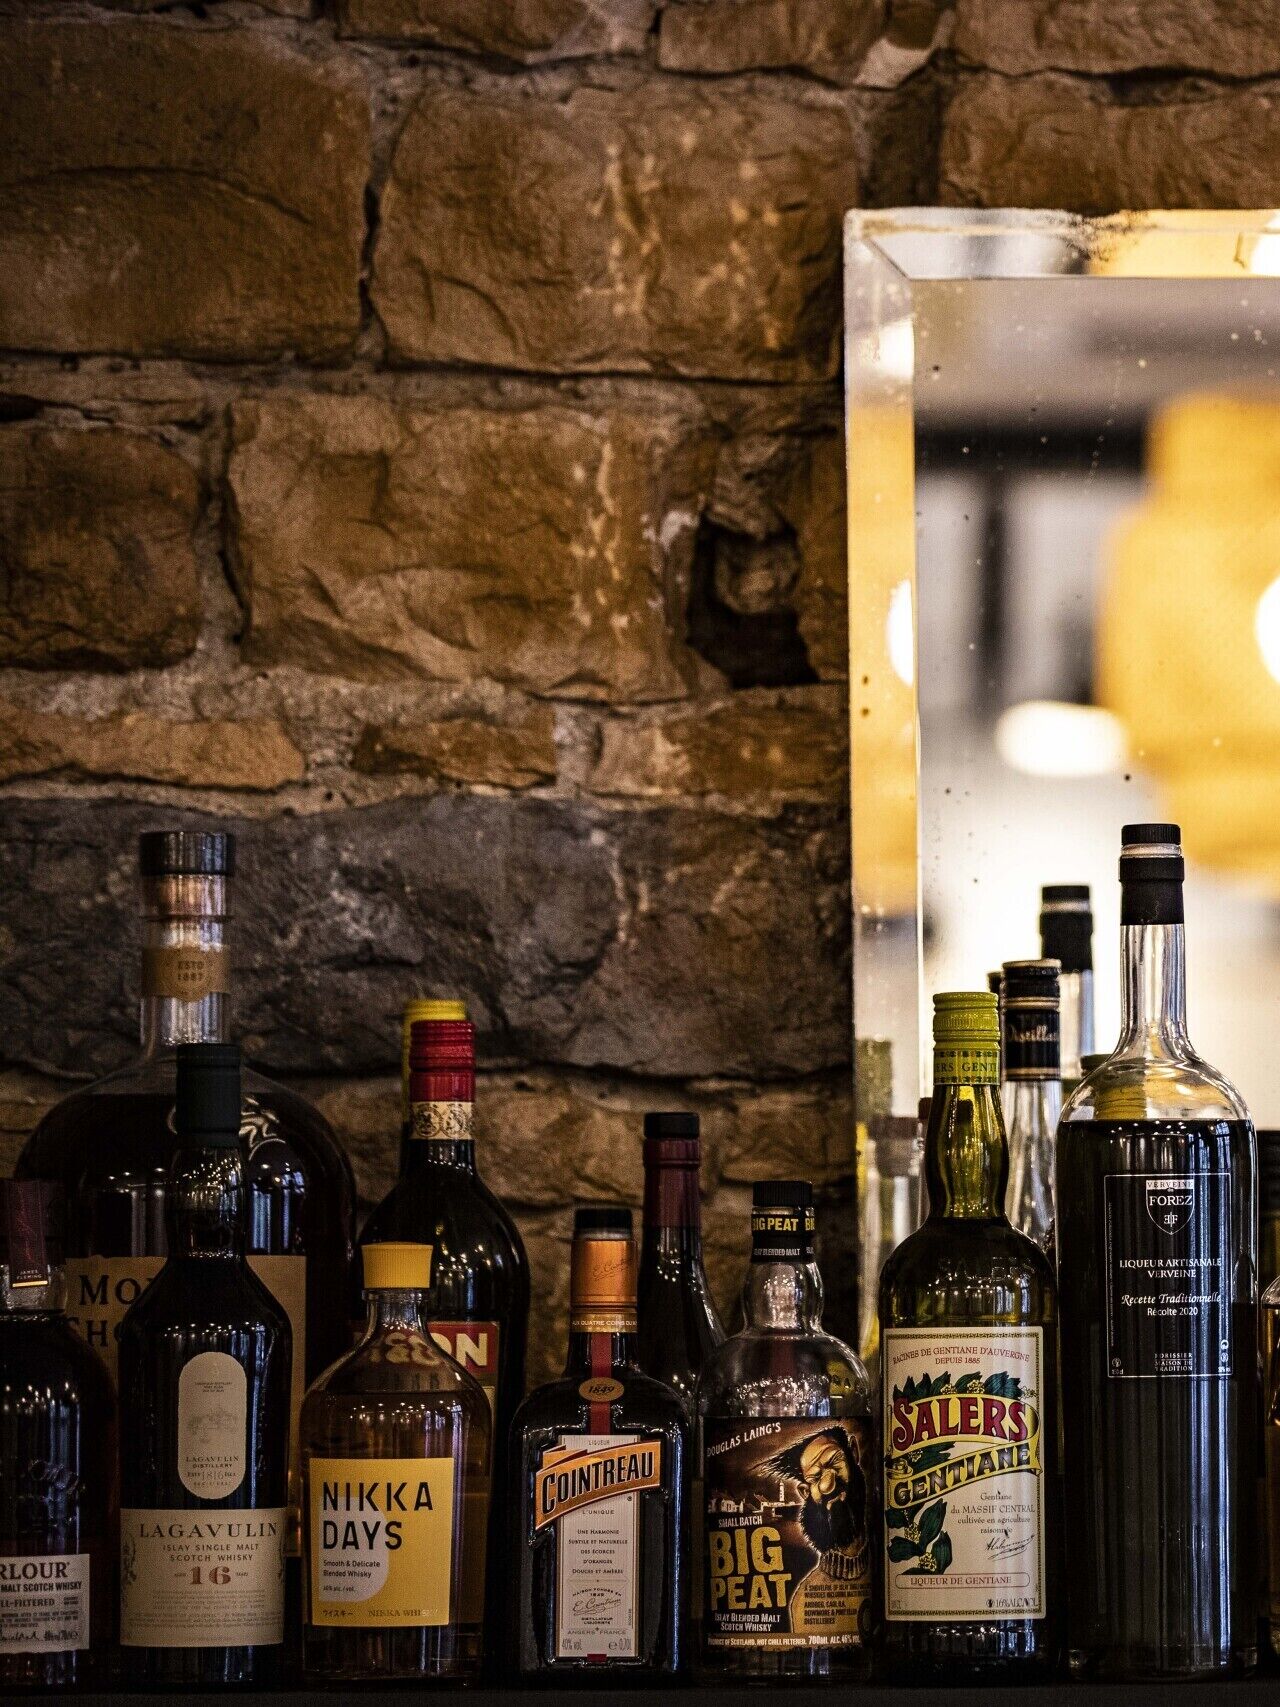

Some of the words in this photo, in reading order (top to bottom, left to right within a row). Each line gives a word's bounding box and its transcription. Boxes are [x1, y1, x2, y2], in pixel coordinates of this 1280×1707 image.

[1149, 1195, 1193, 1206] FOREZ
[767, 1217, 799, 1232] PEAT
[1119, 1259, 1164, 1268] LIQUEUR
[1165, 1258, 1222, 1268] ARTISANALE
[1147, 1269, 1197, 1278] VERVEINE
[1121, 1293, 1156, 1306] Recette
[1158, 1291, 1222, 1304] Traditionnelle
[1147, 1306, 1178, 1316] Récolte
[1178, 1306, 1199, 1316] 2020
[892, 1349, 920, 1365] RACINES
[920, 1347, 932, 1357] DE
[932, 1346, 978, 1355] GENTIANE
[980, 1346, 1030, 1362] D'AUVERGNE
[935, 1356, 962, 1365] DEPUIS
[588, 1384, 615, 1394] 1849
[892, 1395, 1028, 1452] SALERS
[707, 1435, 740, 1457] DOUGLAS
[744, 1422, 782, 1442] LAING'S
[186, 1455, 239, 1464] LAGAVULIN
[893, 1444, 1031, 1507] GENTIANE
[542, 1451, 654, 1515] COINTREAU
[323, 1481, 433, 1512] NIKKA
[980, 1492, 1012, 1500] Gentiane
[950, 1504, 960, 1514] du
[962, 1505, 998, 1514] MASSIF
[998, 1504, 1036, 1513] CENTRAL
[718, 1517, 738, 1528] SMALL
[740, 1515, 762, 1526] BATCH
[958, 1515, 984, 1524] cultivée
[997, 1514, 1031, 1524] agriculture
[140, 1522, 278, 1538] LAGAVULIN
[323, 1520, 403, 1550] DAYS
[709, 1526, 784, 1577] BIG
[324, 1559, 345, 1568] Smooth
[346, 1559, 351, 1568] &
[352, 1559, 381, 1568] Delicate
[189, 1566, 232, 1585] 16
[324, 1570, 346, 1578] Blended
[347, 1570, 372, 1579] Whisky
[1, 1584, 20, 1593] MALT
[22, 1582, 54, 1592] SCOTCH
[56, 1580, 82, 1592] WHISKY
[910, 1576, 948, 1586] LIQUEUR
[950, 1576, 963, 1585] DE
[965, 1576, 1012, 1585] GENTIANE
[711, 1573, 792, 1611] PEAT
[368, 1609, 400, 1617] NIKKA
[731, 1612, 760, 1622] BLENDED
[760, 1613, 781, 1623] MALT
[720, 1622, 744, 1631] SCOTCH
[744, 1622, 772, 1632] WHISKY
